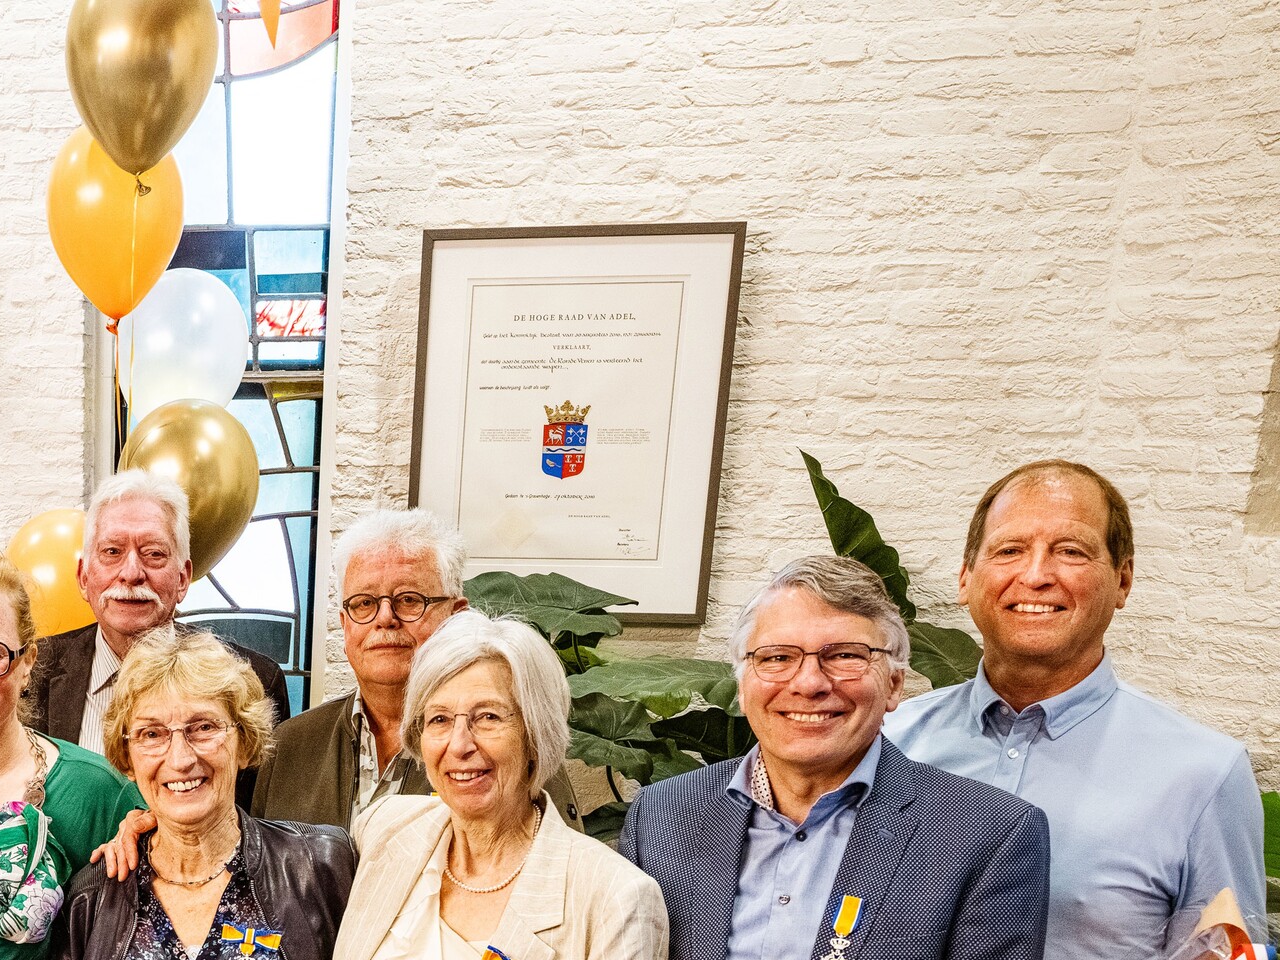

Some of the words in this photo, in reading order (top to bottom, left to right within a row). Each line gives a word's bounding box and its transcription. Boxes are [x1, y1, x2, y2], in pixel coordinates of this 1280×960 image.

[513, 314, 526, 322] DE
[558, 313, 584, 321] RAAD
[609, 312, 637, 320] ADEL,
